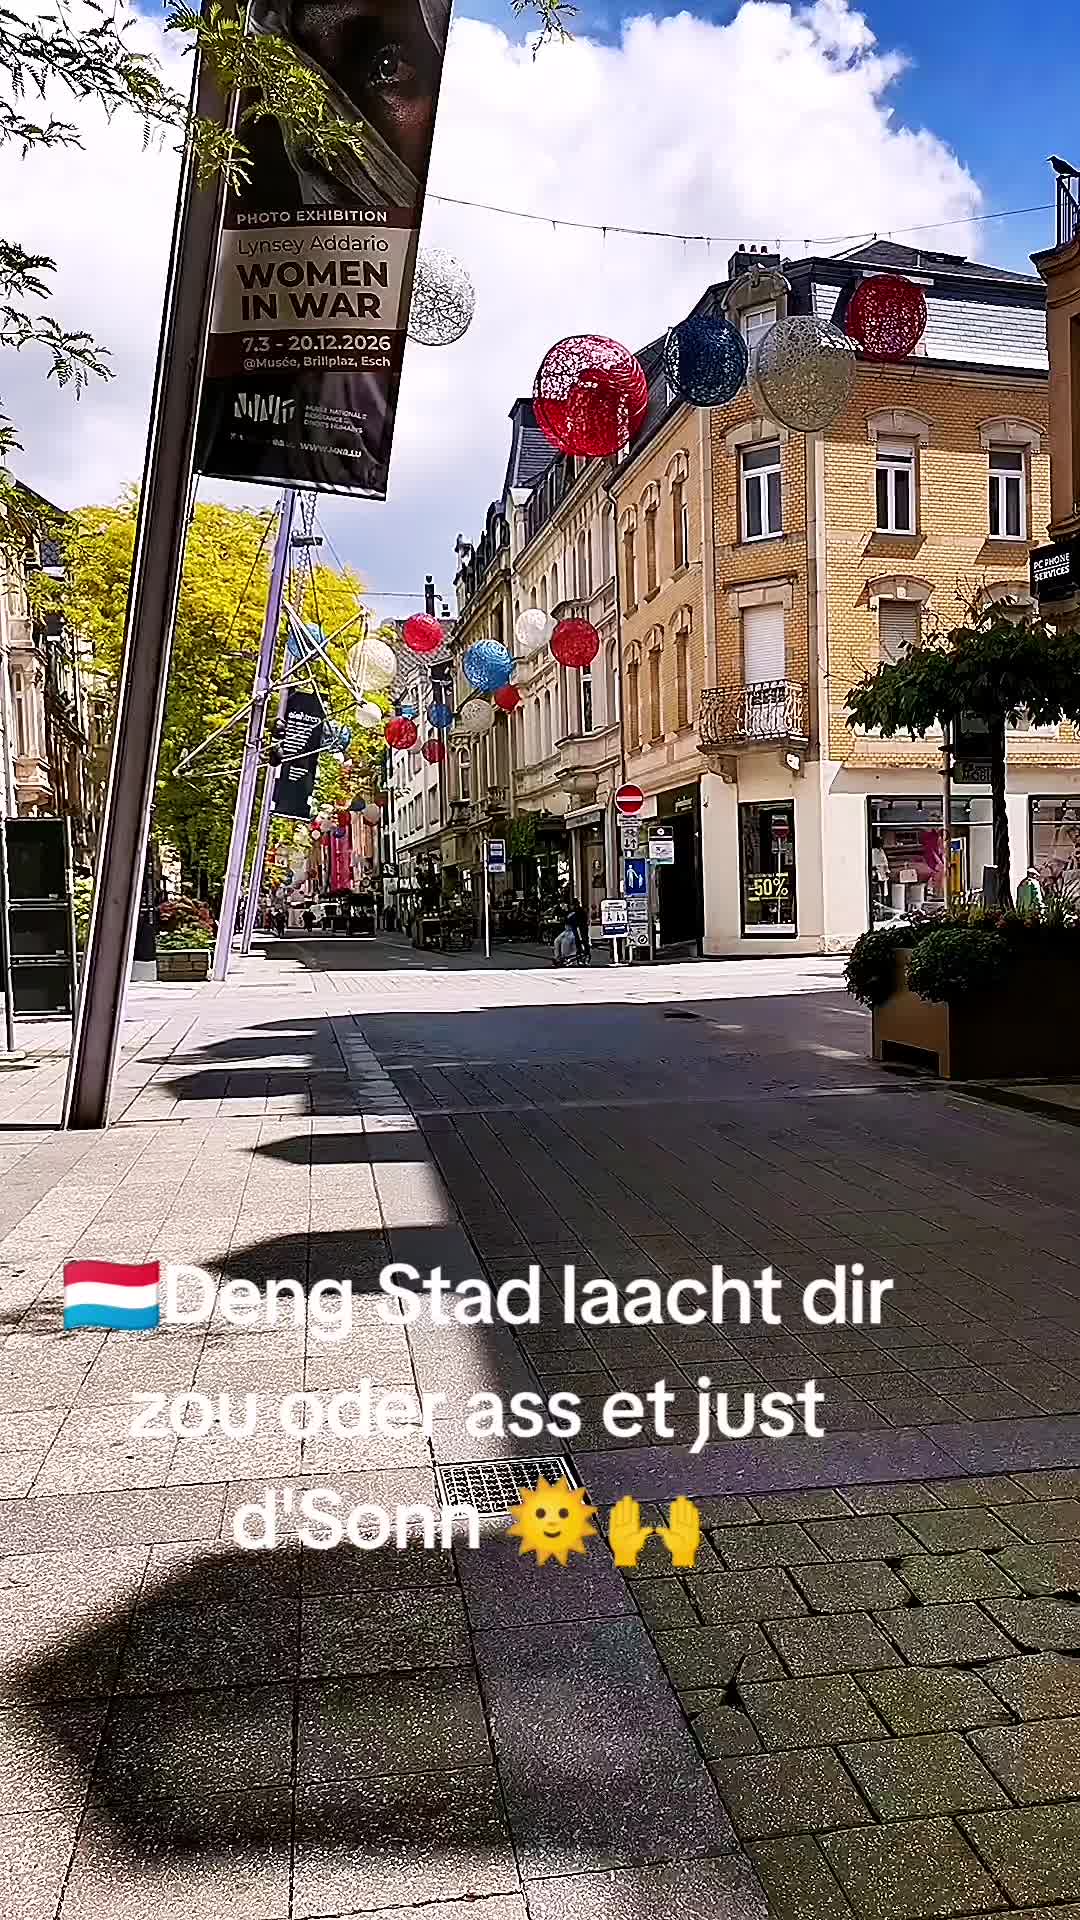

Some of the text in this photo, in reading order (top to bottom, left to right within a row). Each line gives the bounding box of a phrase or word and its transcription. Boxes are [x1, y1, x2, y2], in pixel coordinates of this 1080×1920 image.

[237, 210, 388, 225] PHOTO EXHIBITION
[238, 234, 389, 257] Lynsey Addario
[236, 261, 388, 289] WOMEN
[241, 293, 382, 320] IN WAR
[242, 337, 270, 352] 7.3
[287, 335, 391, 351] 20.12.2026
[303, 355, 358, 368] Brillplaz,
[361, 355, 391, 367] Esch
[1034, 553, 1069, 570] PC PHONE
[1034, 565, 1069, 582] SERVICES
